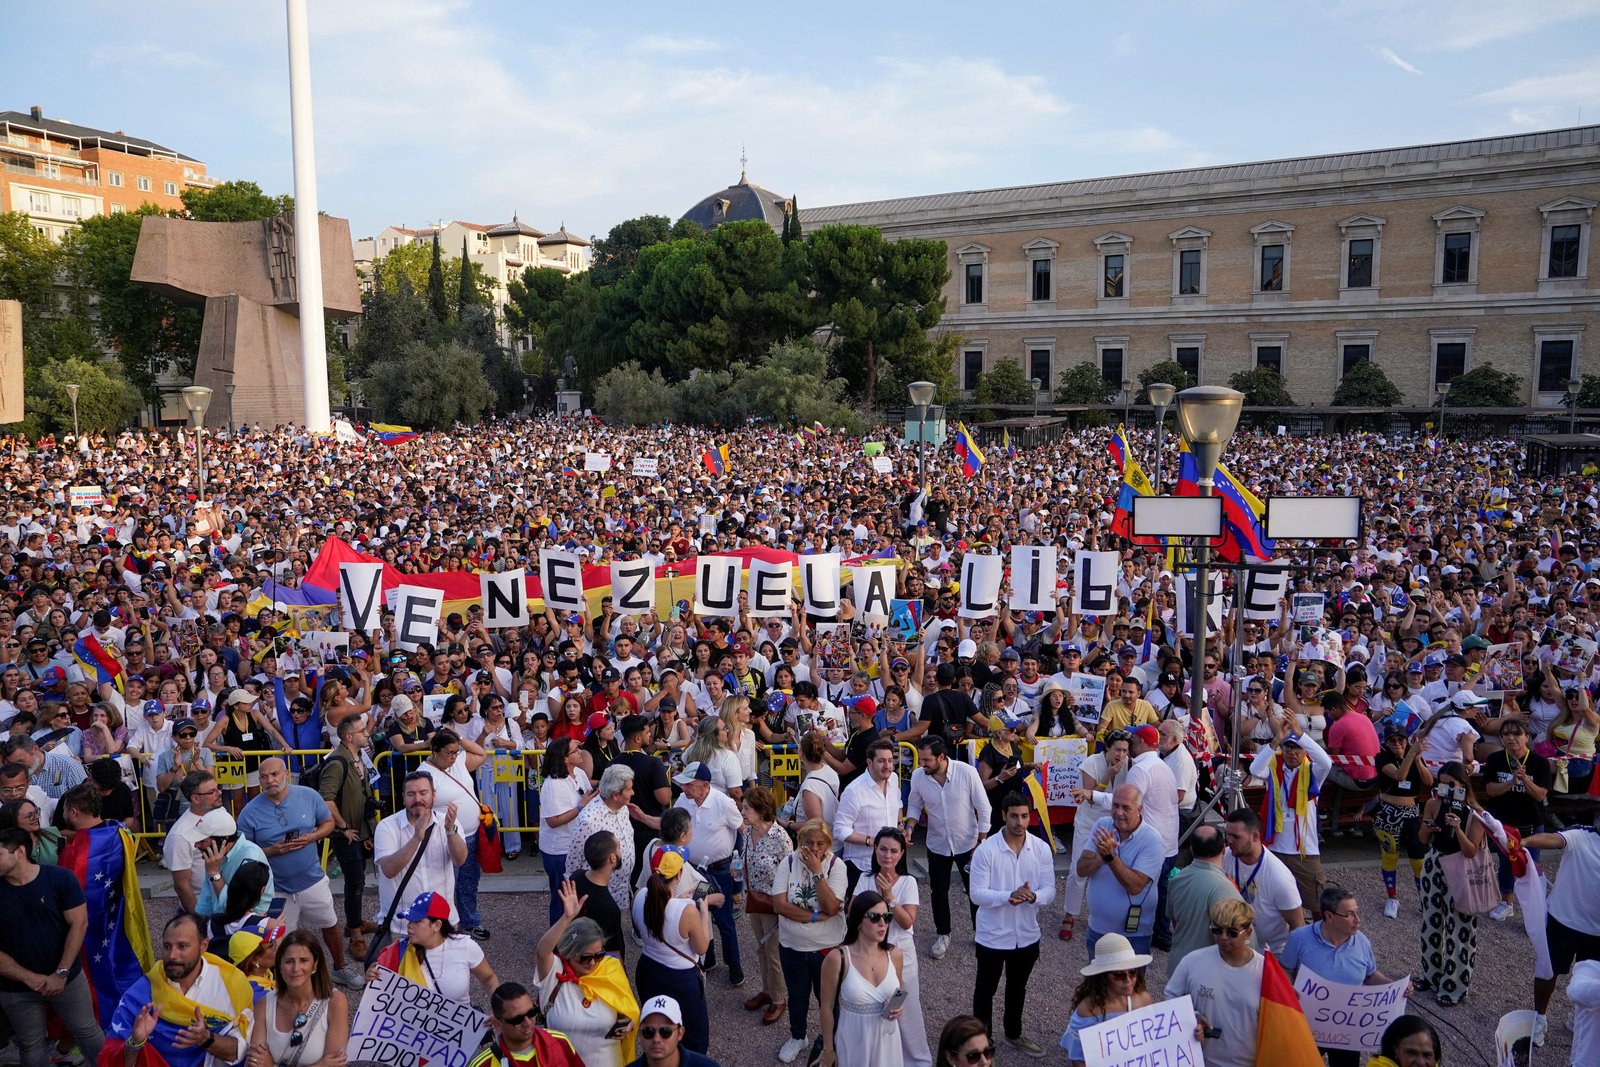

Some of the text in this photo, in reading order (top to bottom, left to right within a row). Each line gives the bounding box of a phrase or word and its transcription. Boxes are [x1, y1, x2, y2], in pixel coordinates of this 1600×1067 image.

[217, 765, 244, 779] PM
[773, 758, 799, 771] PM
[391, 976, 456, 1020] POBRE
[450, 1004, 485, 1034] EN
[1301, 978, 1400, 1008] NO ESTÁN
[351, 1011, 468, 1067] LIBERTAD
[371, 993, 464, 1049] SU CHOZA
